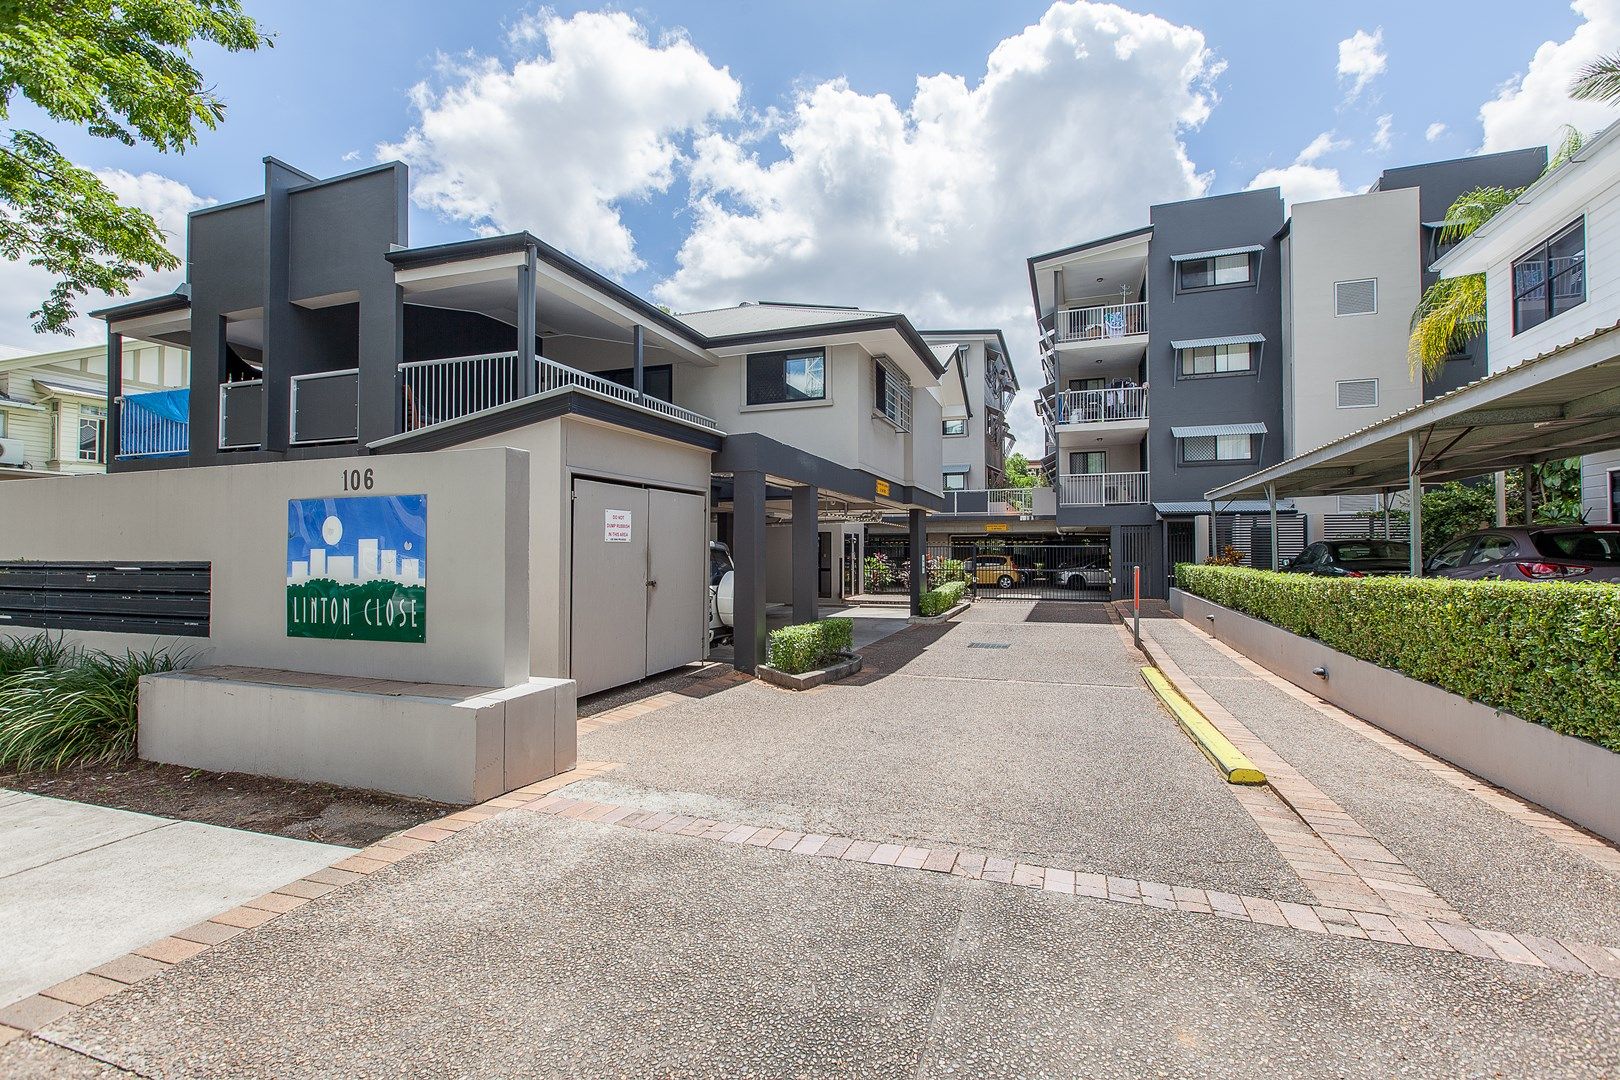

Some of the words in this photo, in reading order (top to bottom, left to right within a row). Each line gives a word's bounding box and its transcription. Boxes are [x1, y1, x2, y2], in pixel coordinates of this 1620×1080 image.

[343, 468, 374, 491] 106
[293, 596, 350, 625] LINTON
[364, 598, 417, 628] CLOSE
